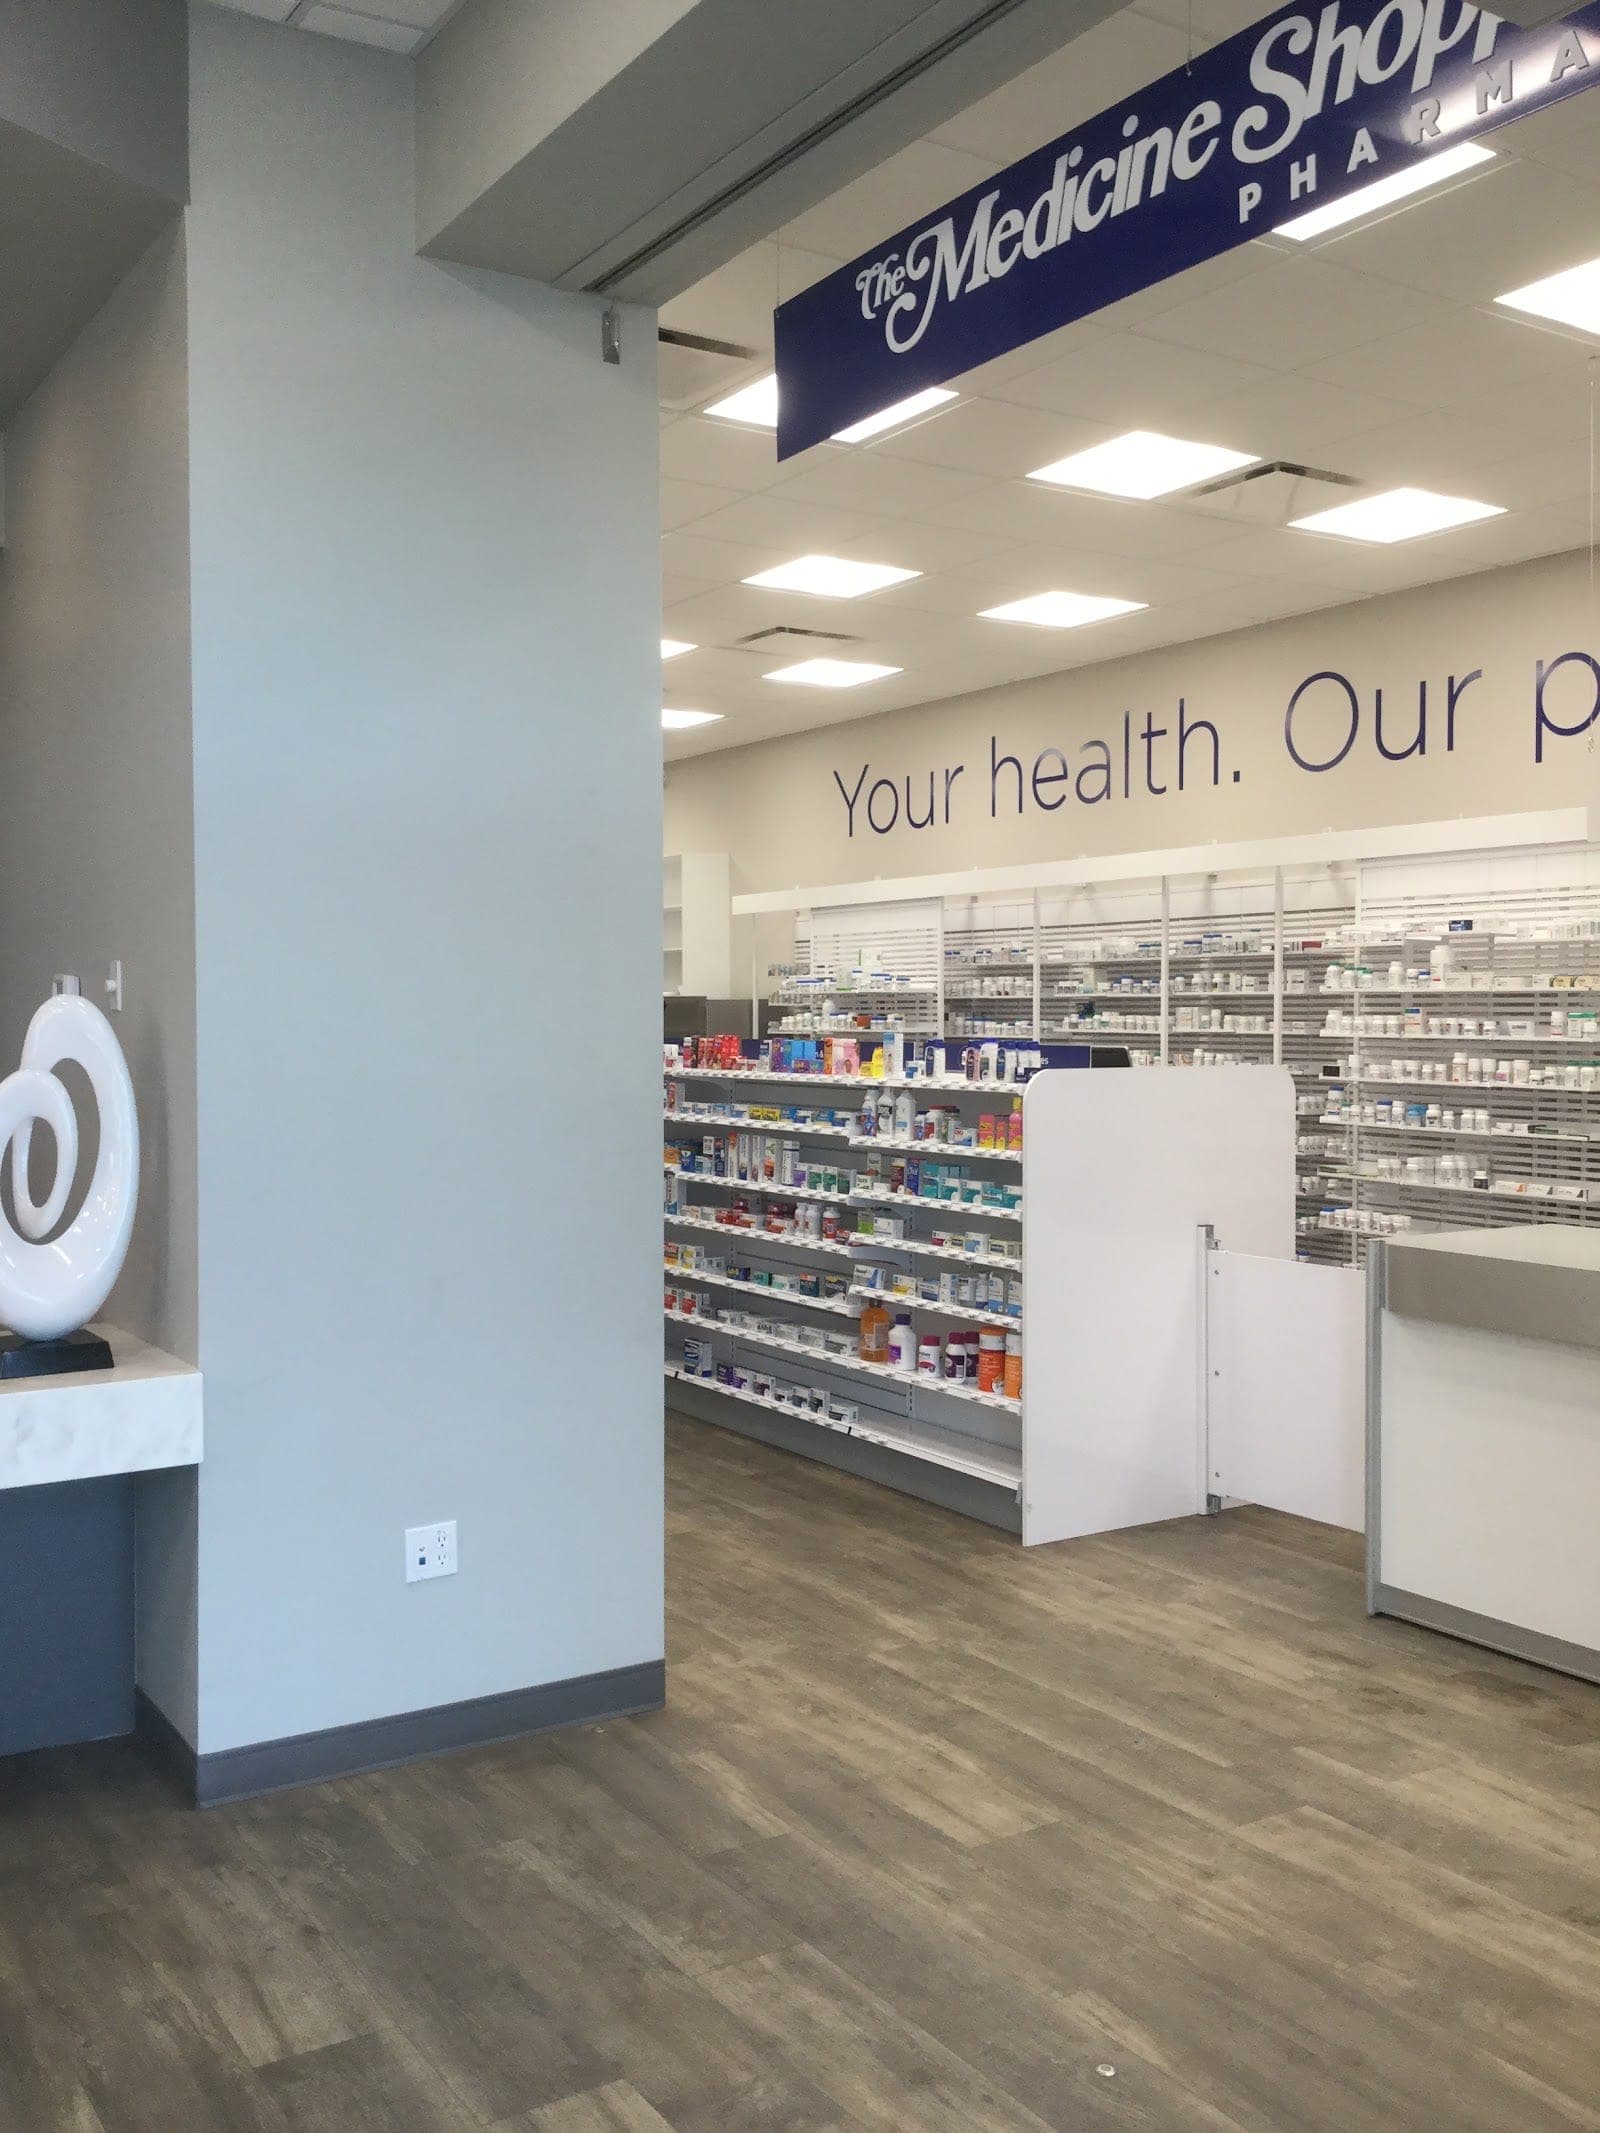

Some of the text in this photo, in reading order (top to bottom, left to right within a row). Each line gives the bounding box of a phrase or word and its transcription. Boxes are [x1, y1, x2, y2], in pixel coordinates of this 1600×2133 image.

[856, 252, 904, 320] The
[884, 98, 1220, 353] Medicine
[833, 764, 964, 837] Your
[990, 698, 1241, 818] health.
[1285, 669, 1483, 772] Our
